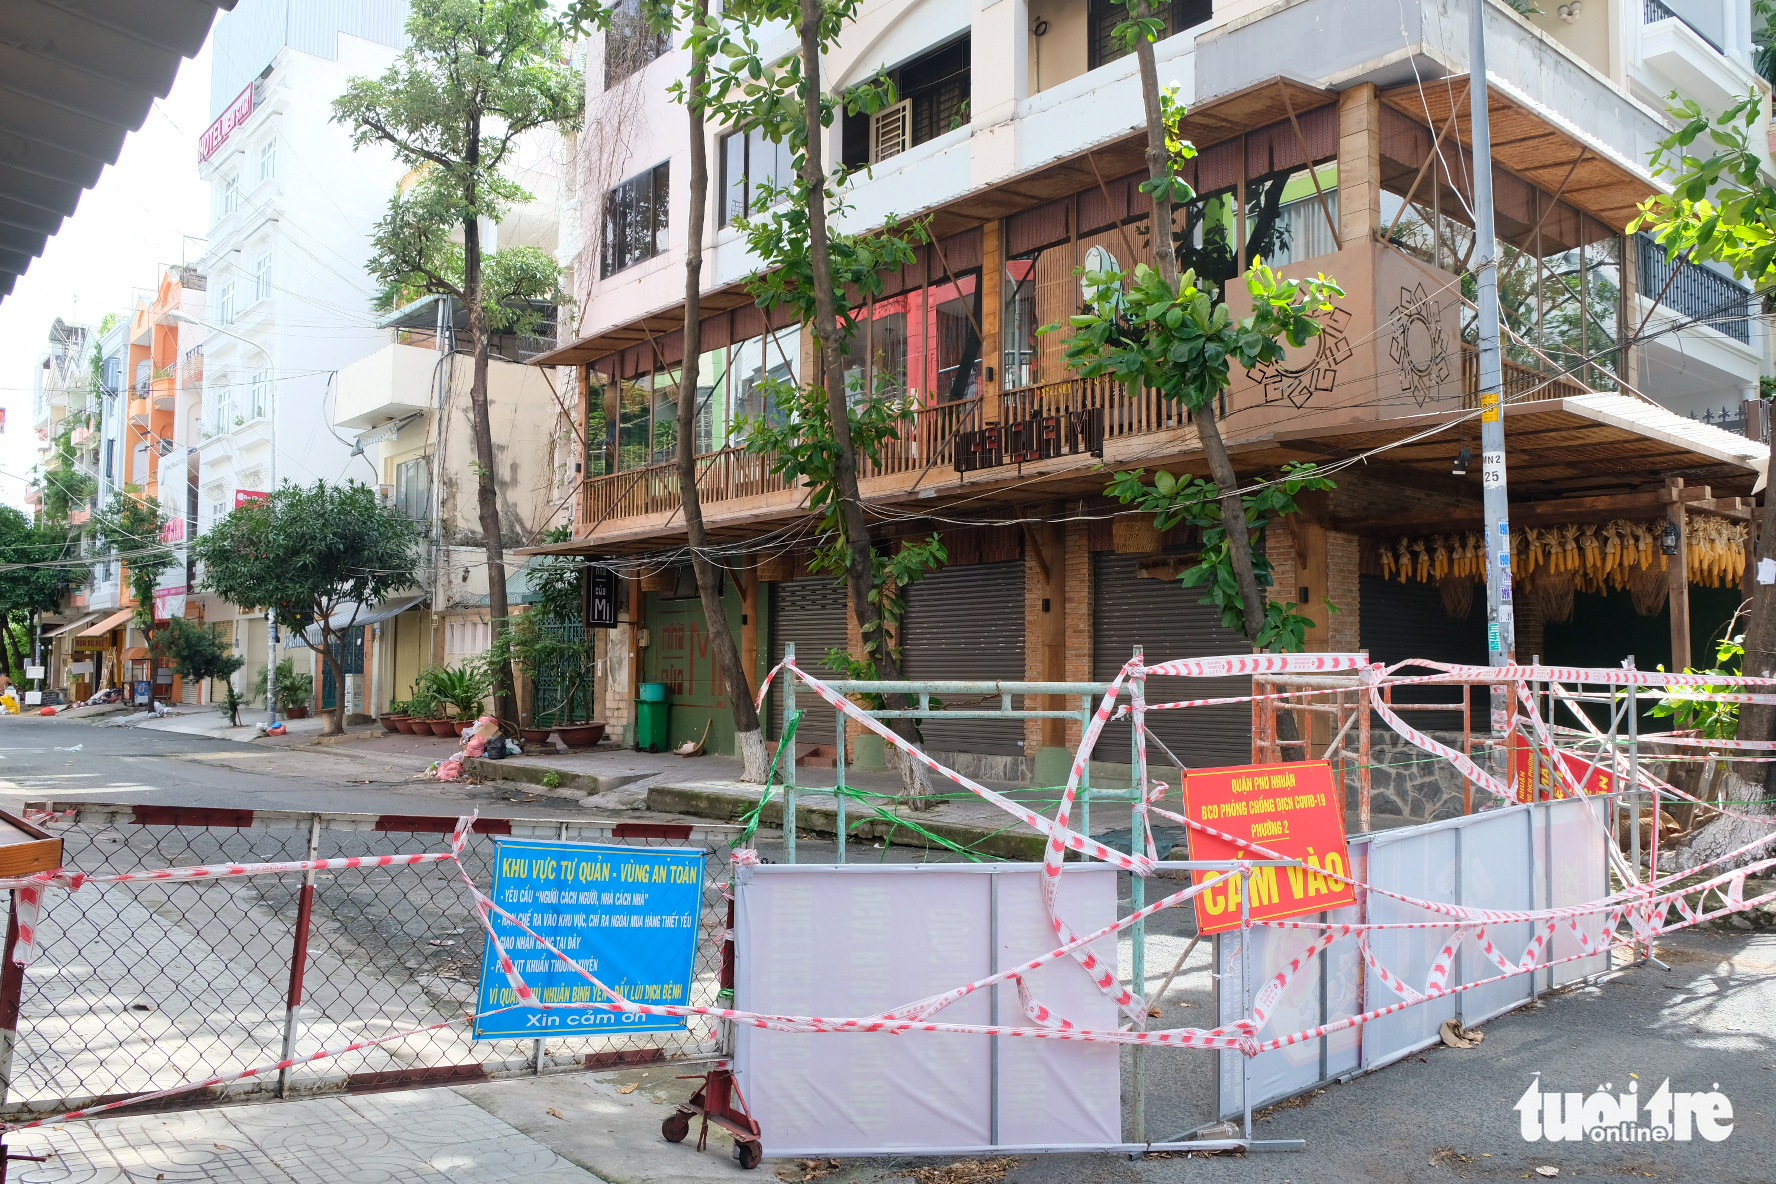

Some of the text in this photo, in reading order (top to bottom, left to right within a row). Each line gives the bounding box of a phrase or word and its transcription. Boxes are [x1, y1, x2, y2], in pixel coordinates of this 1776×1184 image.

[1485, 471, 1499, 482] 25
[1232, 772, 1297, 795] QUẬN PHÚ NHUẬN
[1220, 799, 1248, 818] PHÒNG
[1249, 795, 1276, 815] CHỐNG
[1276, 796, 1294, 813] DỊCH
[1295, 793, 1327, 810] COVID-19
[1251, 819, 1290, 839] PHƯỜNG 2
[502, 858, 529, 879] KHU
[532, 856, 557, 883] VỰC
[560, 857, 578, 884] TỰ
[579, 855, 611, 884] QUẢN
[621, 859, 650, 883] VÙNG
[652, 865, 668, 883] AN
[670, 861, 698, 884] TOÀN
[1202, 846, 1346, 916] CẤM VÀO
[505, 885, 519, 903] YÊU
[520, 884, 534, 903] CẦU
[561, 888, 578, 905] CÁCH
[601, 889, 614, 905] NHÀ
[615, 889, 632, 906] CÁCH
[517, 908, 532, 927] CHẾ
[533, 913, 541, 927] RA
[544, 910, 557, 927] VÀO
[558, 914, 572, 927] KHU
[601, 914, 609, 928] RA
[611, 911, 630, 928] NGOÀI
[630, 915, 644, 928] MUA
[645, 912, 660, 928] HÀNG
[662, 911, 679, 928] THIẾT
[680, 911, 692, 928] YẾU
[499, 936, 514, 950] GIAO
[516, 934, 534, 952] NHẬN
[556, 936, 566, 952] TẠI
[567, 933, 581, 950] ĐÂY
[526, 953, 550, 973] KHUẨN
[489, 983, 499, 1004] VÌ
[572, 982, 591, 1002] BÌNH
[631, 981, 644, 1000] LÙI
[644, 984, 662, 1003] DỊCH
[663, 980, 683, 1003] BỆNH
[526, 1013, 560, 1027] Xin
[567, 1010, 615, 1025] cảm
